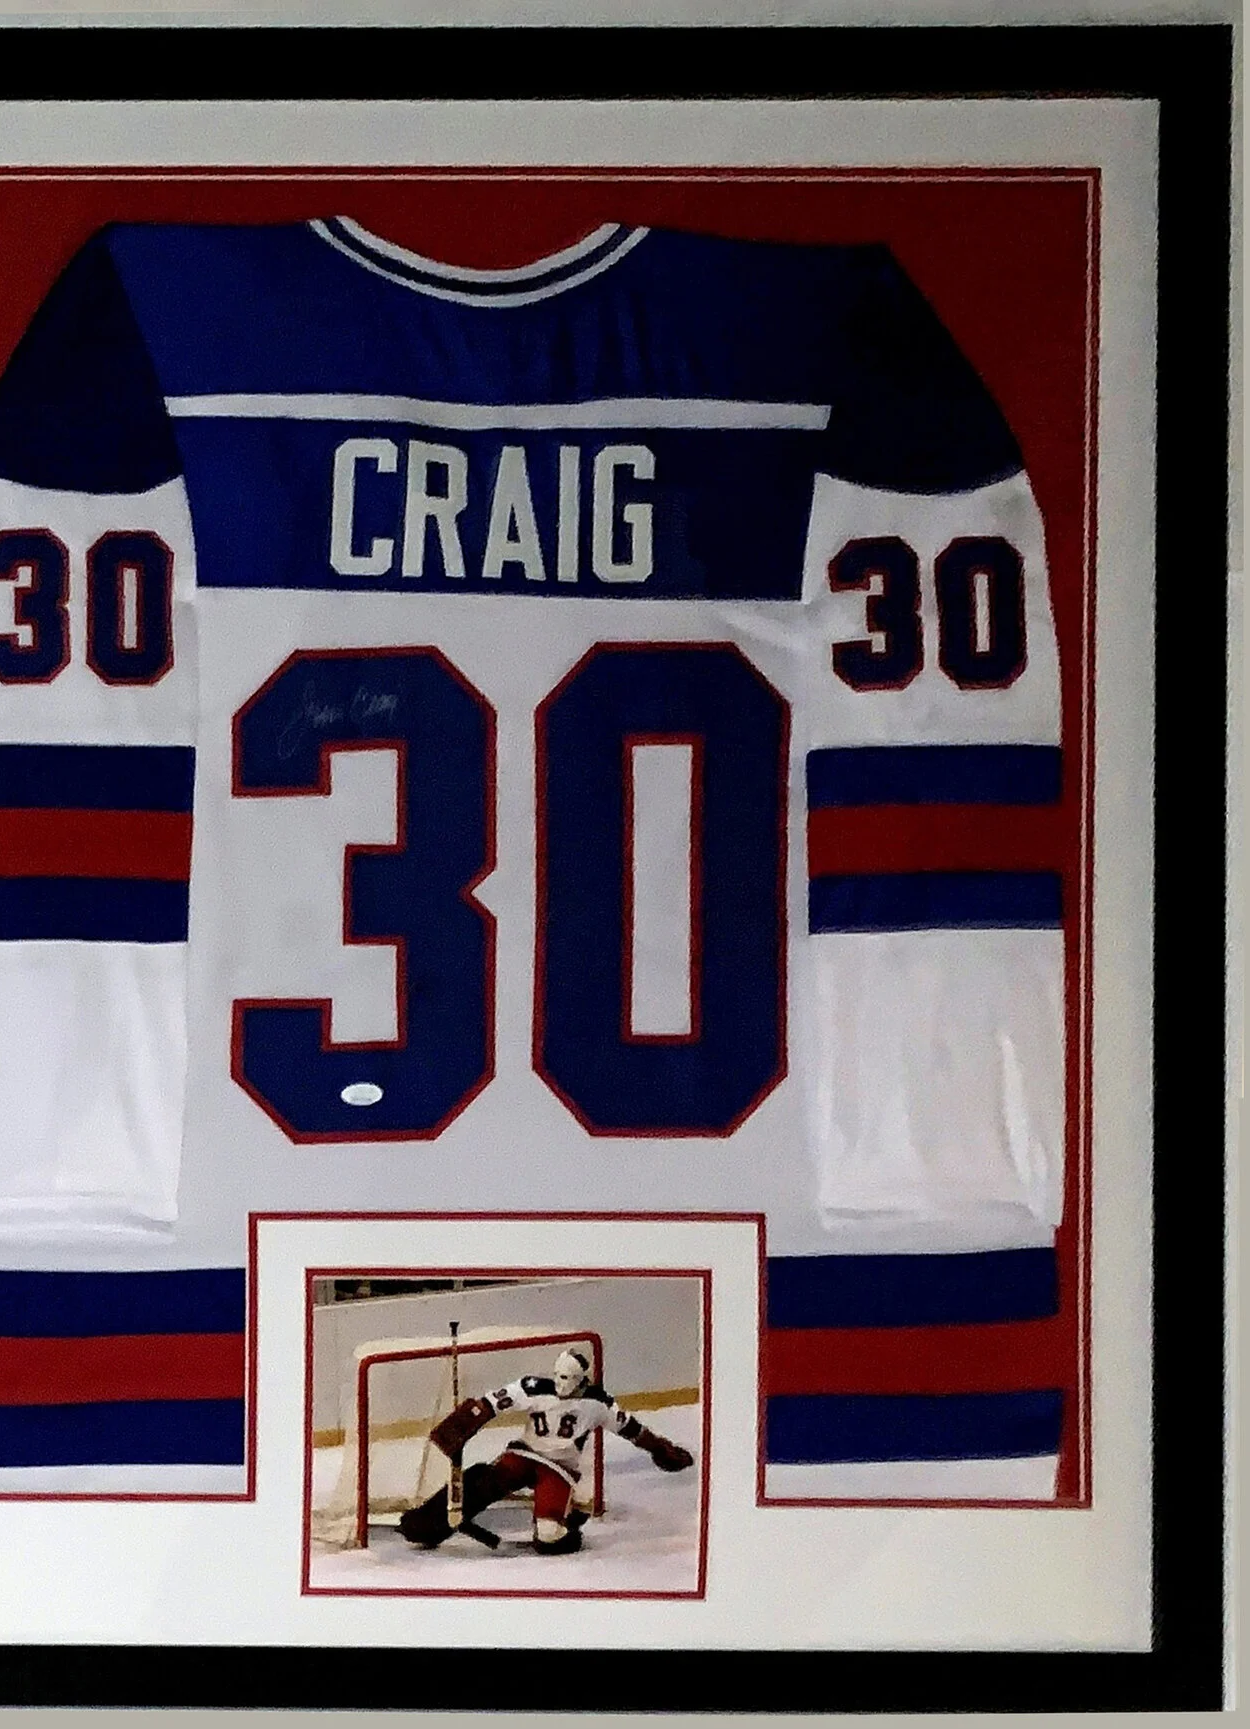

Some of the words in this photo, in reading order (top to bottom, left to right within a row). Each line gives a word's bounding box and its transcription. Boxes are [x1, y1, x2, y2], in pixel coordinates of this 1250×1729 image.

[329, 437, 655, 583] CRAIG
[829, 535, 1026, 691] 30
[231, 641, 792, 1145] 30
